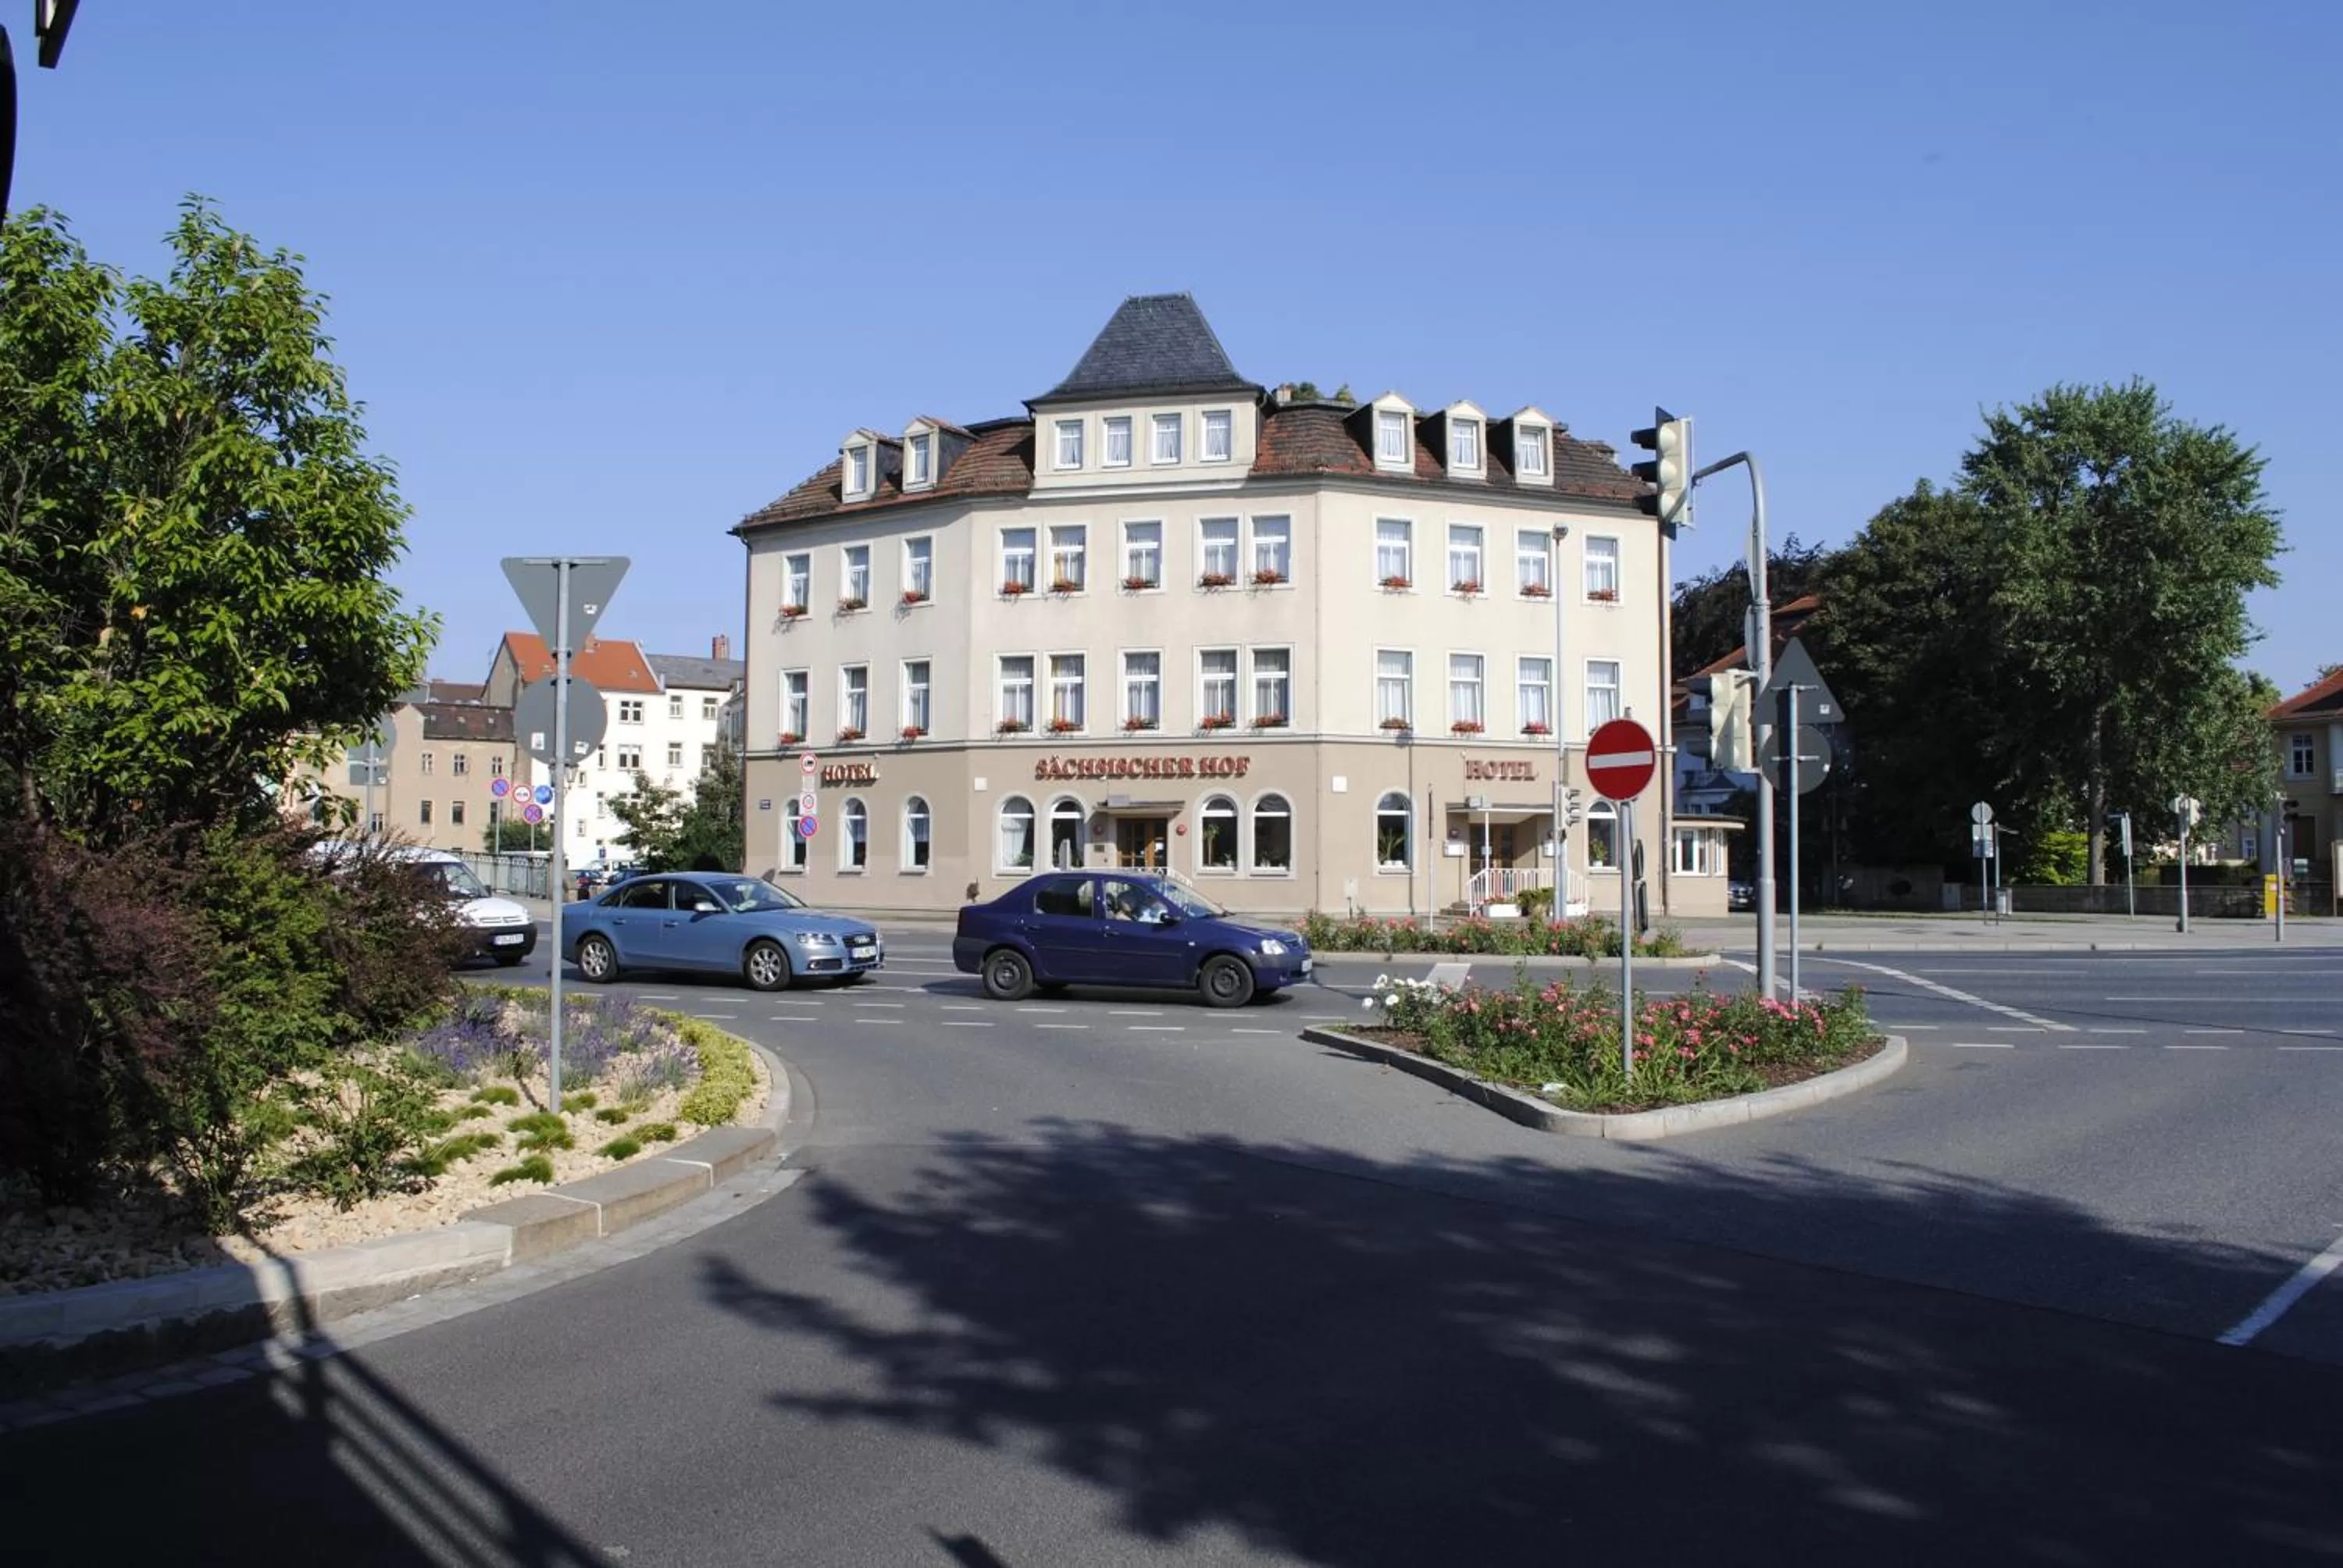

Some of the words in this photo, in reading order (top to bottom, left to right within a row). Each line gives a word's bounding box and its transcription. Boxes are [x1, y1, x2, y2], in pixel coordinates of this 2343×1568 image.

[822, 763, 879, 782] HOTEL
[1035, 755, 1194, 777] SÄCHSISCHER
[1198, 756, 1250, 776] HOF
[1465, 760, 1536, 779] HOTEL
